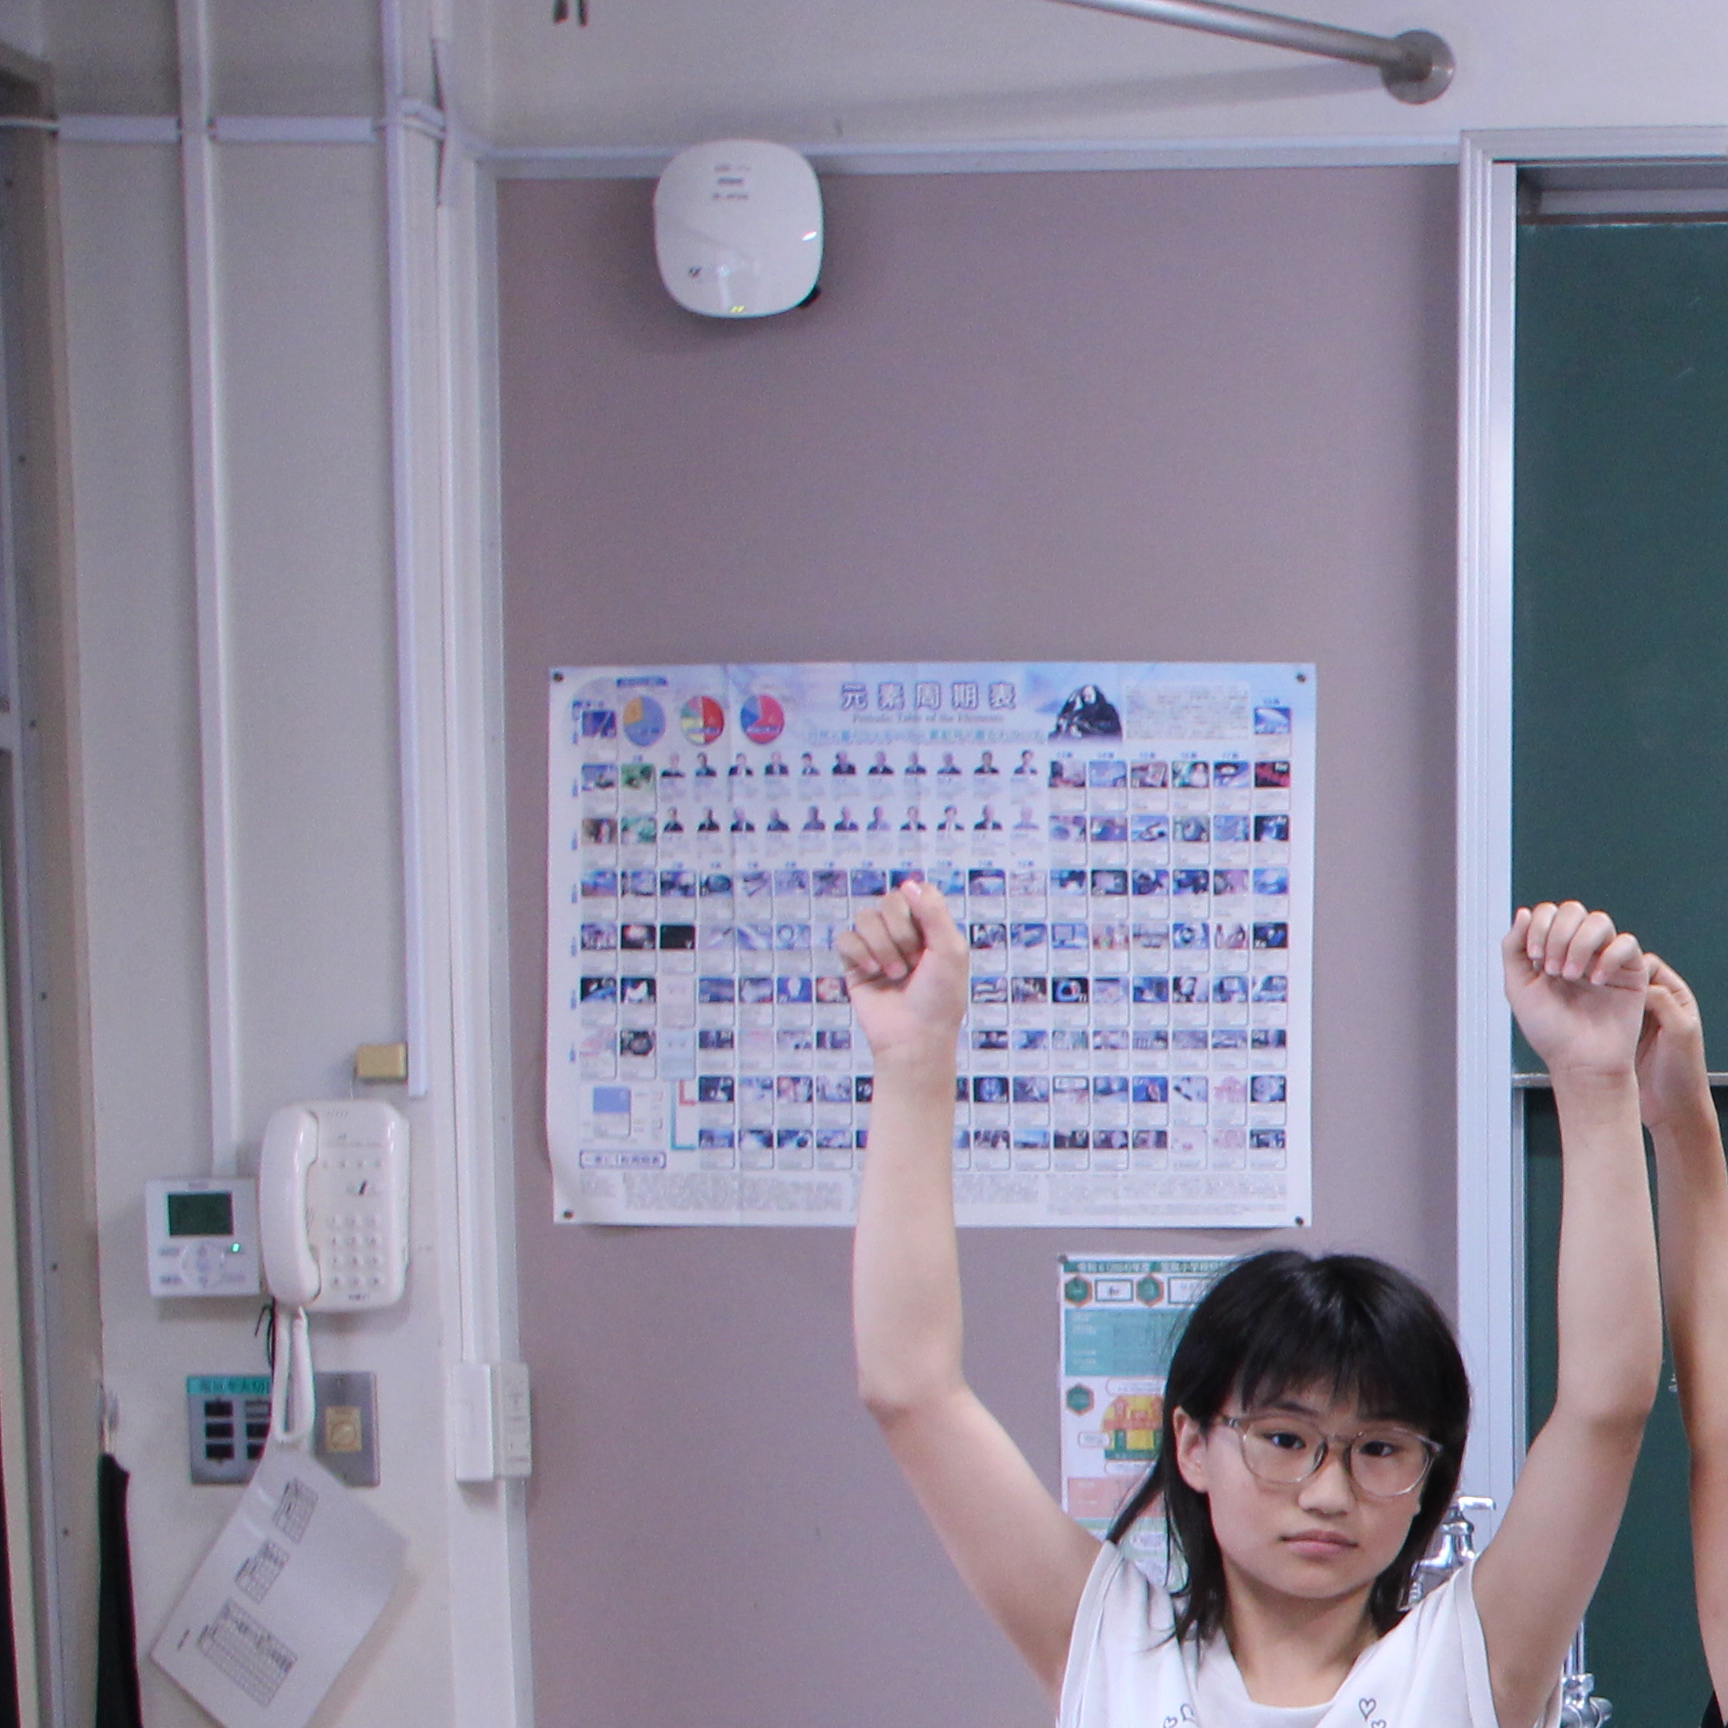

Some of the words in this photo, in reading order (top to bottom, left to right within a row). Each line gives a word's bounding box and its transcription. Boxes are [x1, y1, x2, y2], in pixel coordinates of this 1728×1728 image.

[840, 681, 1017, 711] 元素周期表
